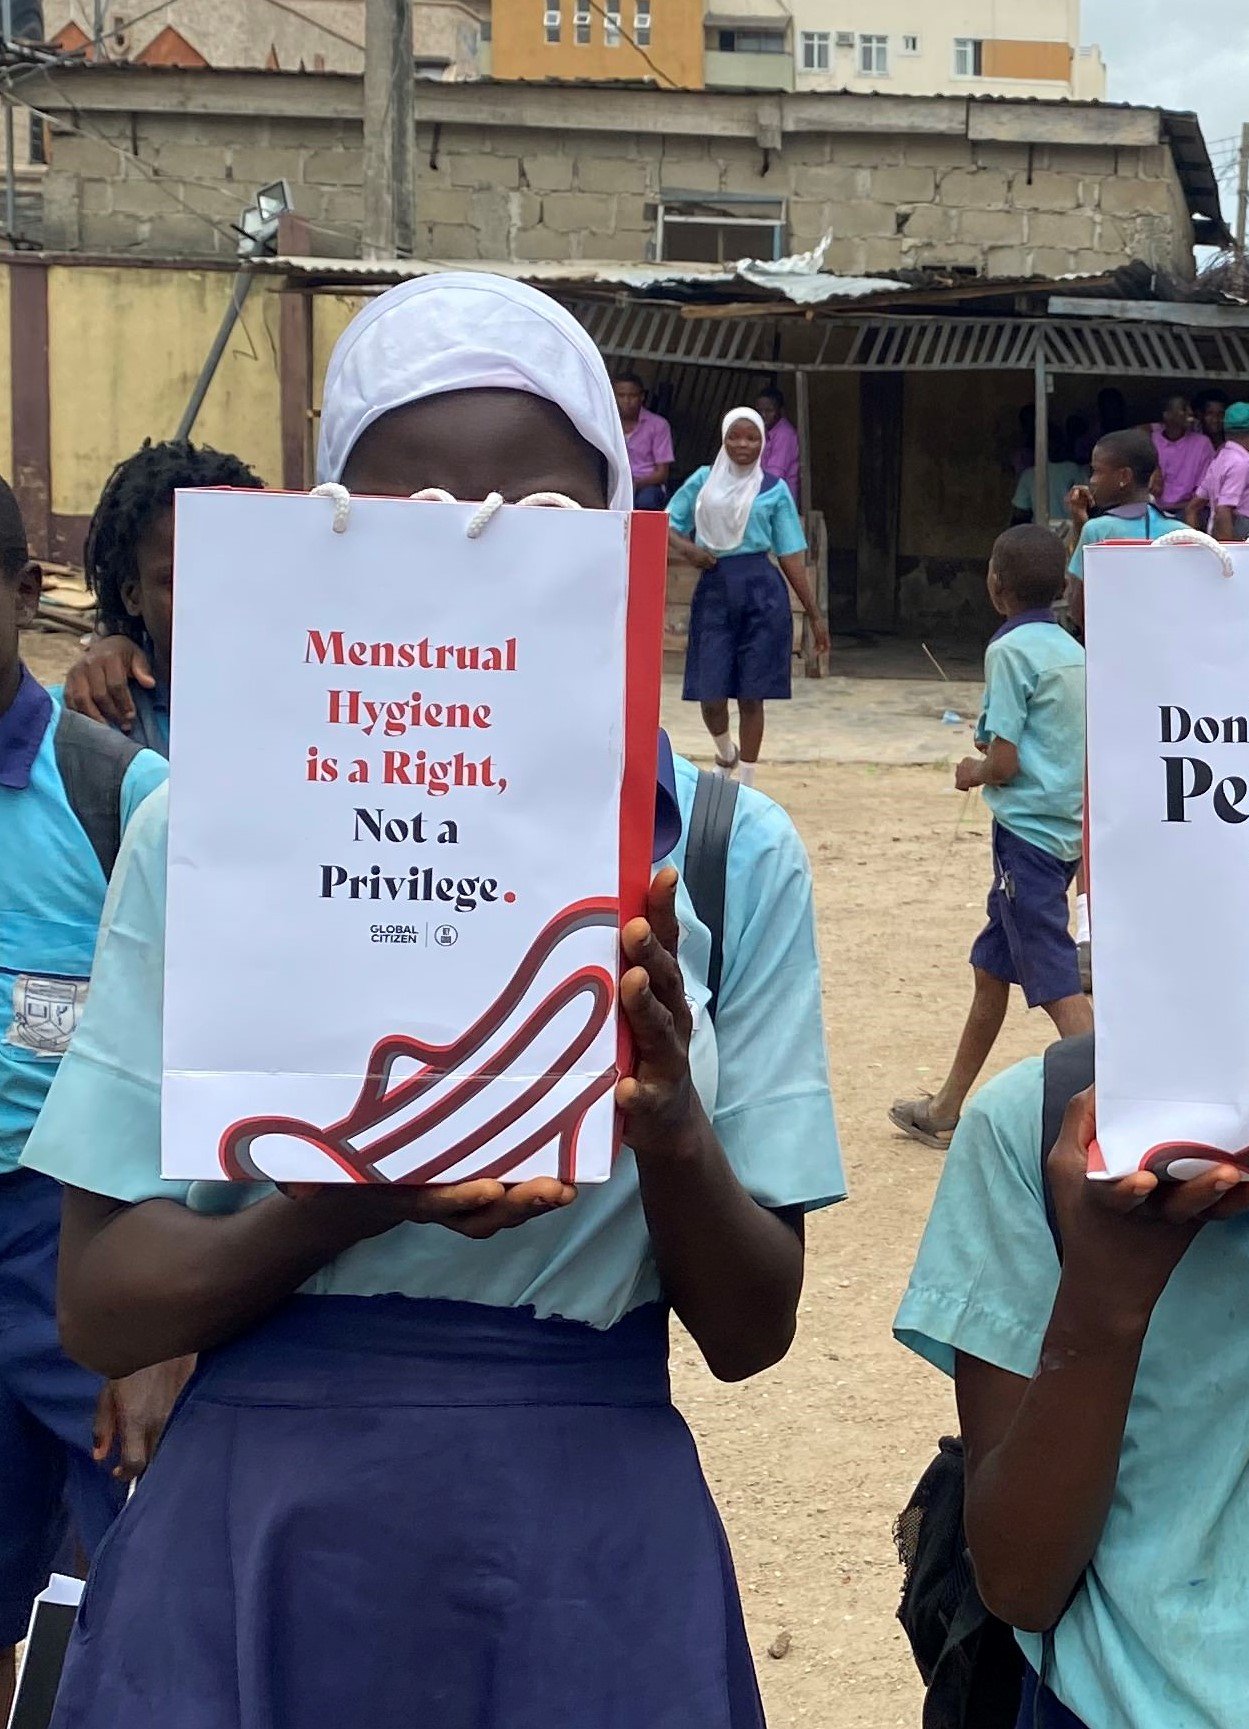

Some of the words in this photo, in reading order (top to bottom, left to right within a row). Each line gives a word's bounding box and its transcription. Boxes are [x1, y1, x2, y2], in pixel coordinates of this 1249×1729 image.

[305, 629, 518, 672] Menstrual
[327, 689, 493, 738] Hygiene
[306, 746, 339, 784] is
[347, 759, 370, 785] a
[382, 750, 508, 798] Right,
[352, 807, 429, 845] Not
[436, 819, 460, 846] a
[318, 864, 518, 913] Privilege.
[369, 924, 420, 934] GLOBAL
[370, 934, 418, 944] CITIZEN
